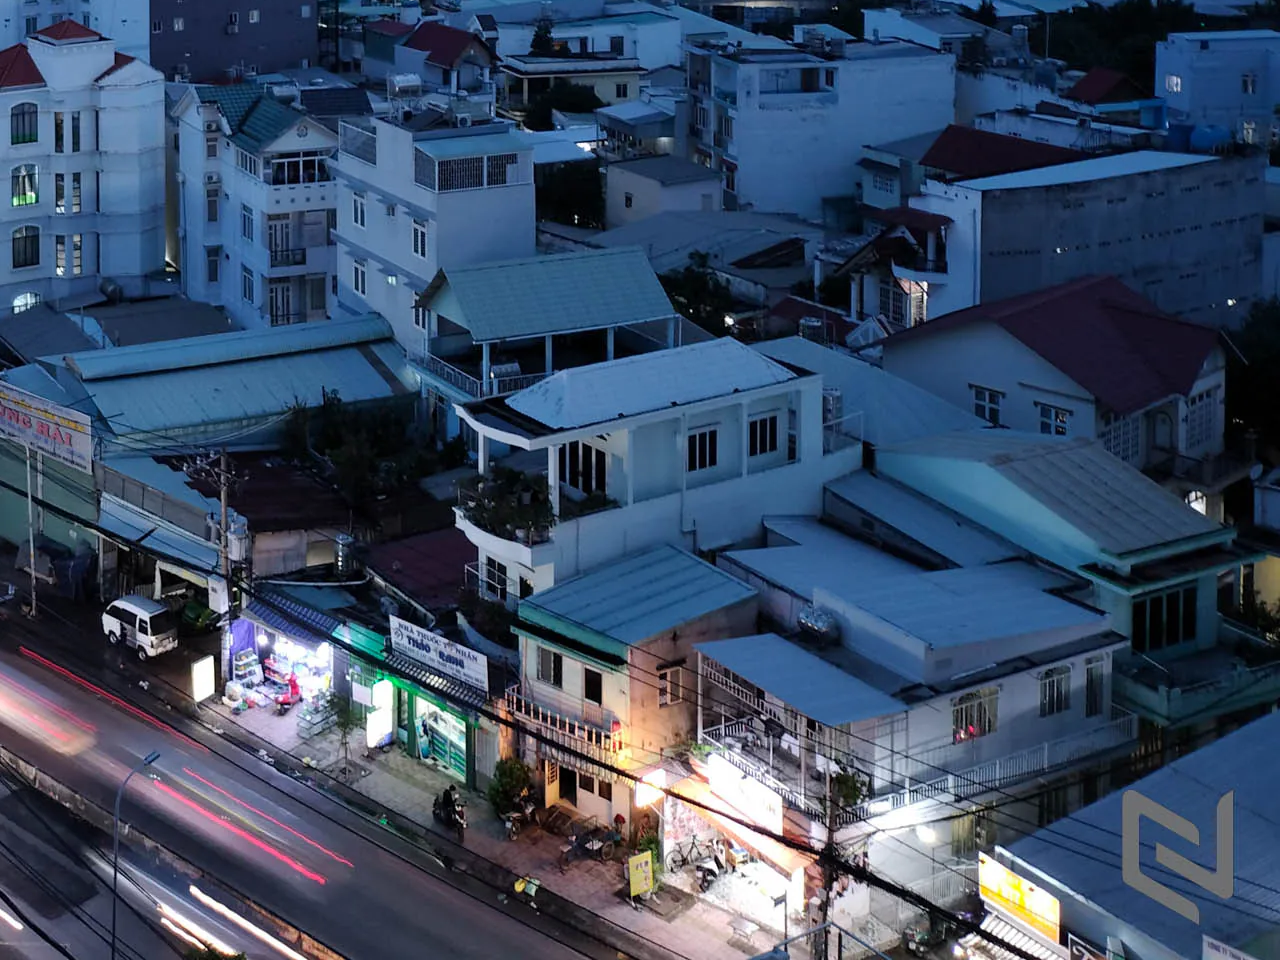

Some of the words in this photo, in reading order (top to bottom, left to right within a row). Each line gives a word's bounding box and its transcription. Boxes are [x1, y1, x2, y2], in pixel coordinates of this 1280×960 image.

[398, 622, 414, 634] NHÀ
[416, 630, 440, 645] THUỐC
[455, 647, 478, 662] NHÂN
